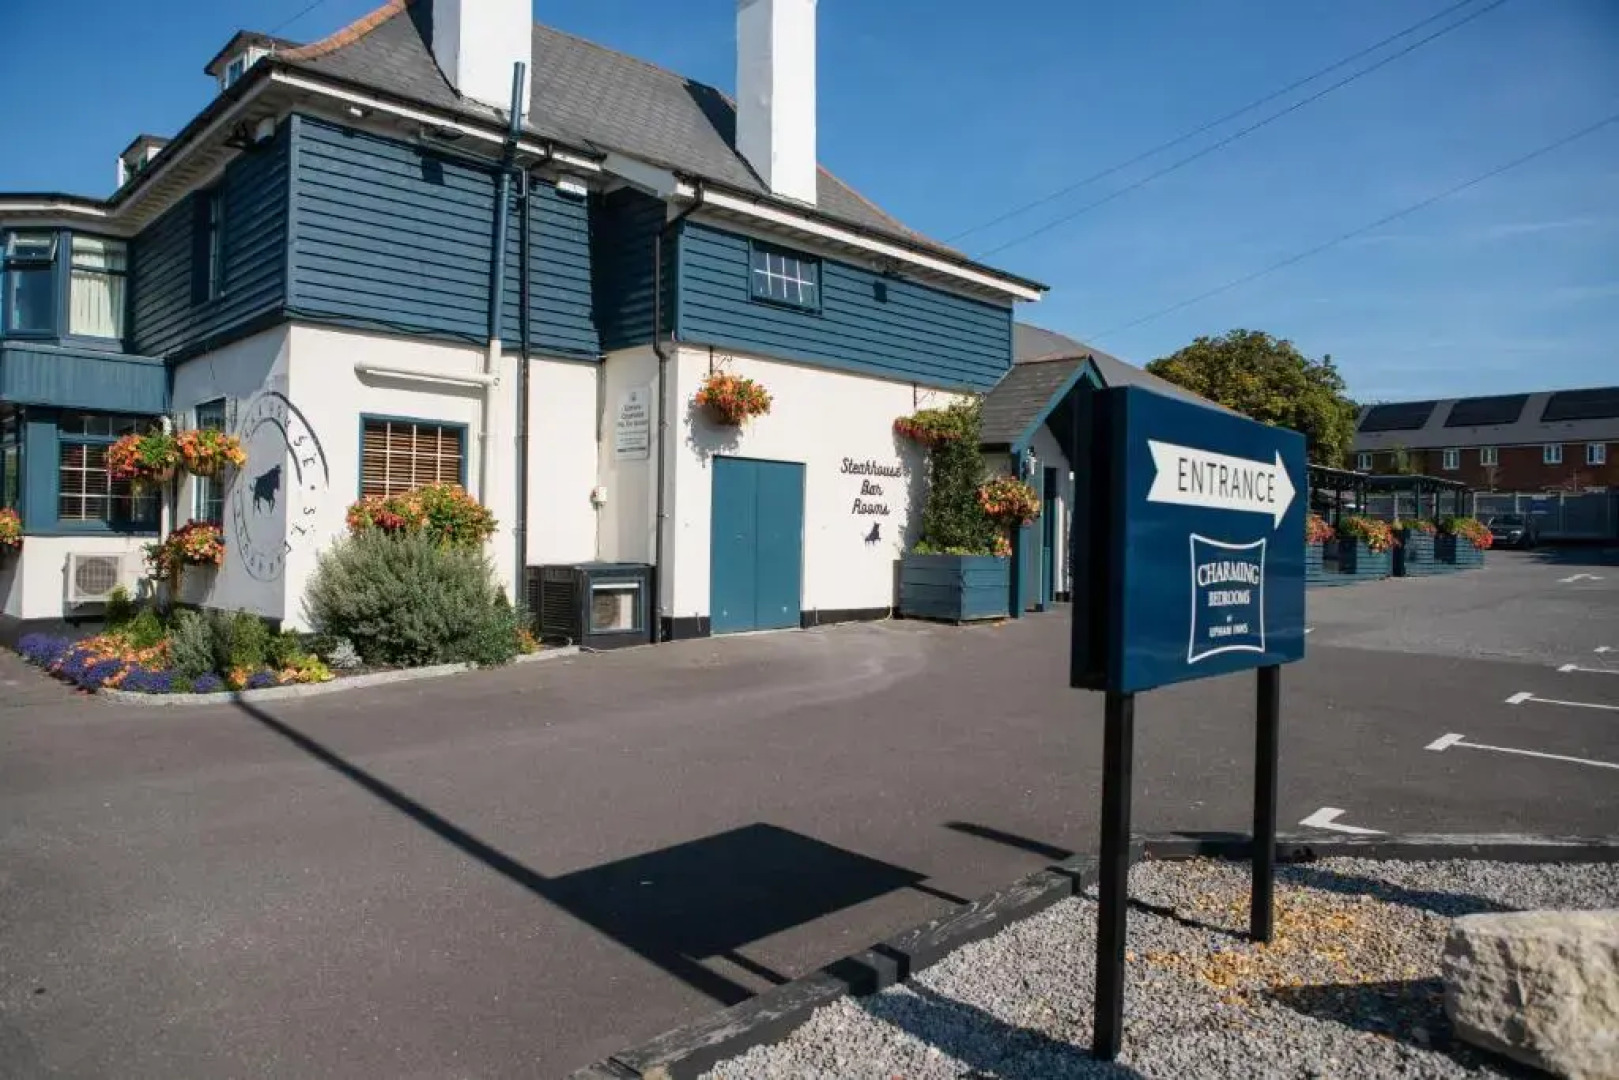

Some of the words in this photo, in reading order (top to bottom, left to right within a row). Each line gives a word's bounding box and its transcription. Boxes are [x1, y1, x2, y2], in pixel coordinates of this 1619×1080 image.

[840, 457, 902, 478] Steakhouse
[860, 478, 884, 496] Bar
[1178, 457, 1276, 504] ENTRANCE
[851, 498, 891, 516] Rooms
[1197, 561, 1259, 586] CHARMING
[1208, 589, 1250, 607] BEDROOMS
